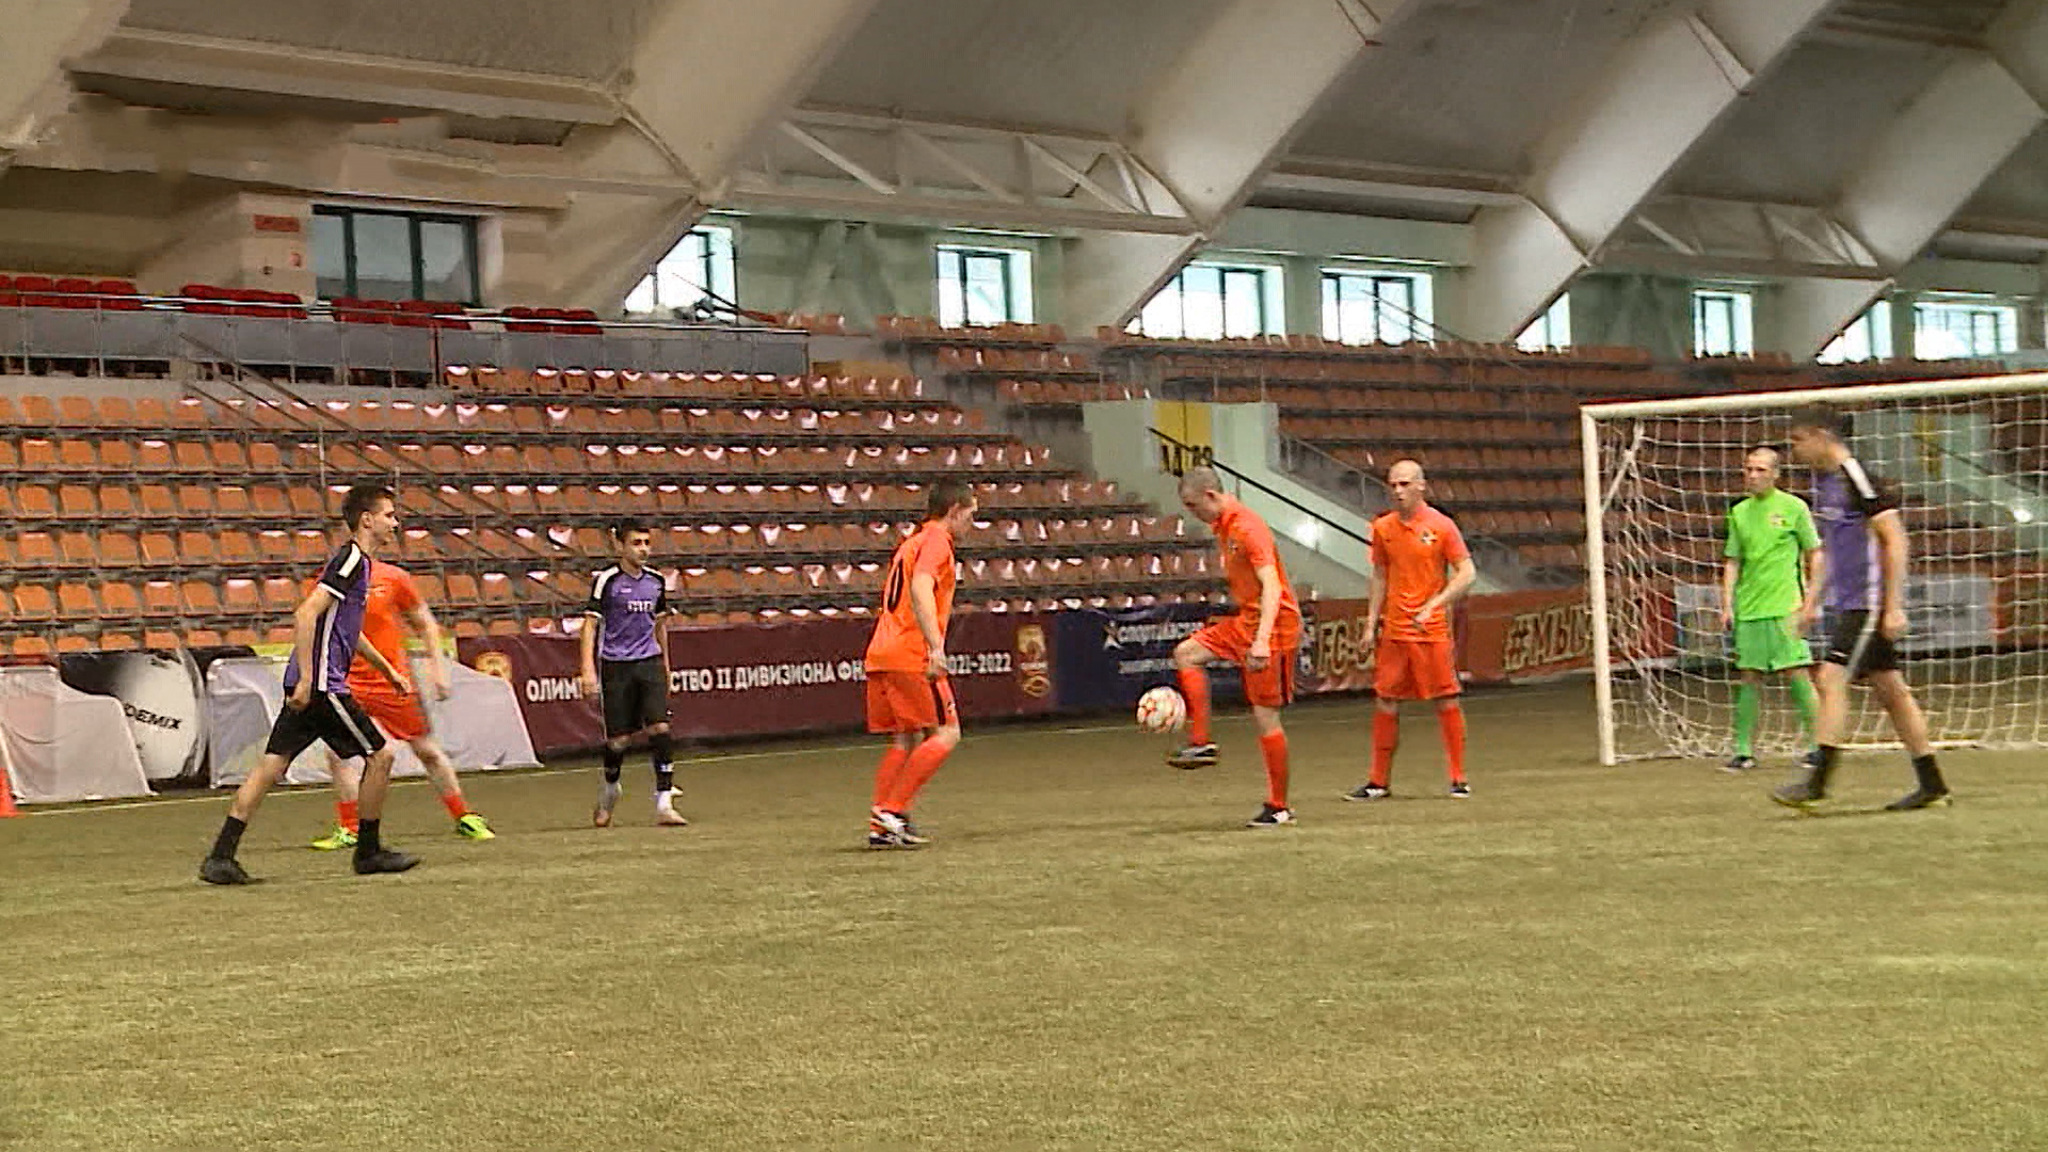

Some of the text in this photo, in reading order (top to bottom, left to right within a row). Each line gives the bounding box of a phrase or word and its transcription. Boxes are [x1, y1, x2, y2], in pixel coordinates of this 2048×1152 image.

[526, 676, 583, 702] ОЛИМ
[670, 667, 713, 693] СТВО
[735, 660, 836, 692] ДИВИЗИОНА
